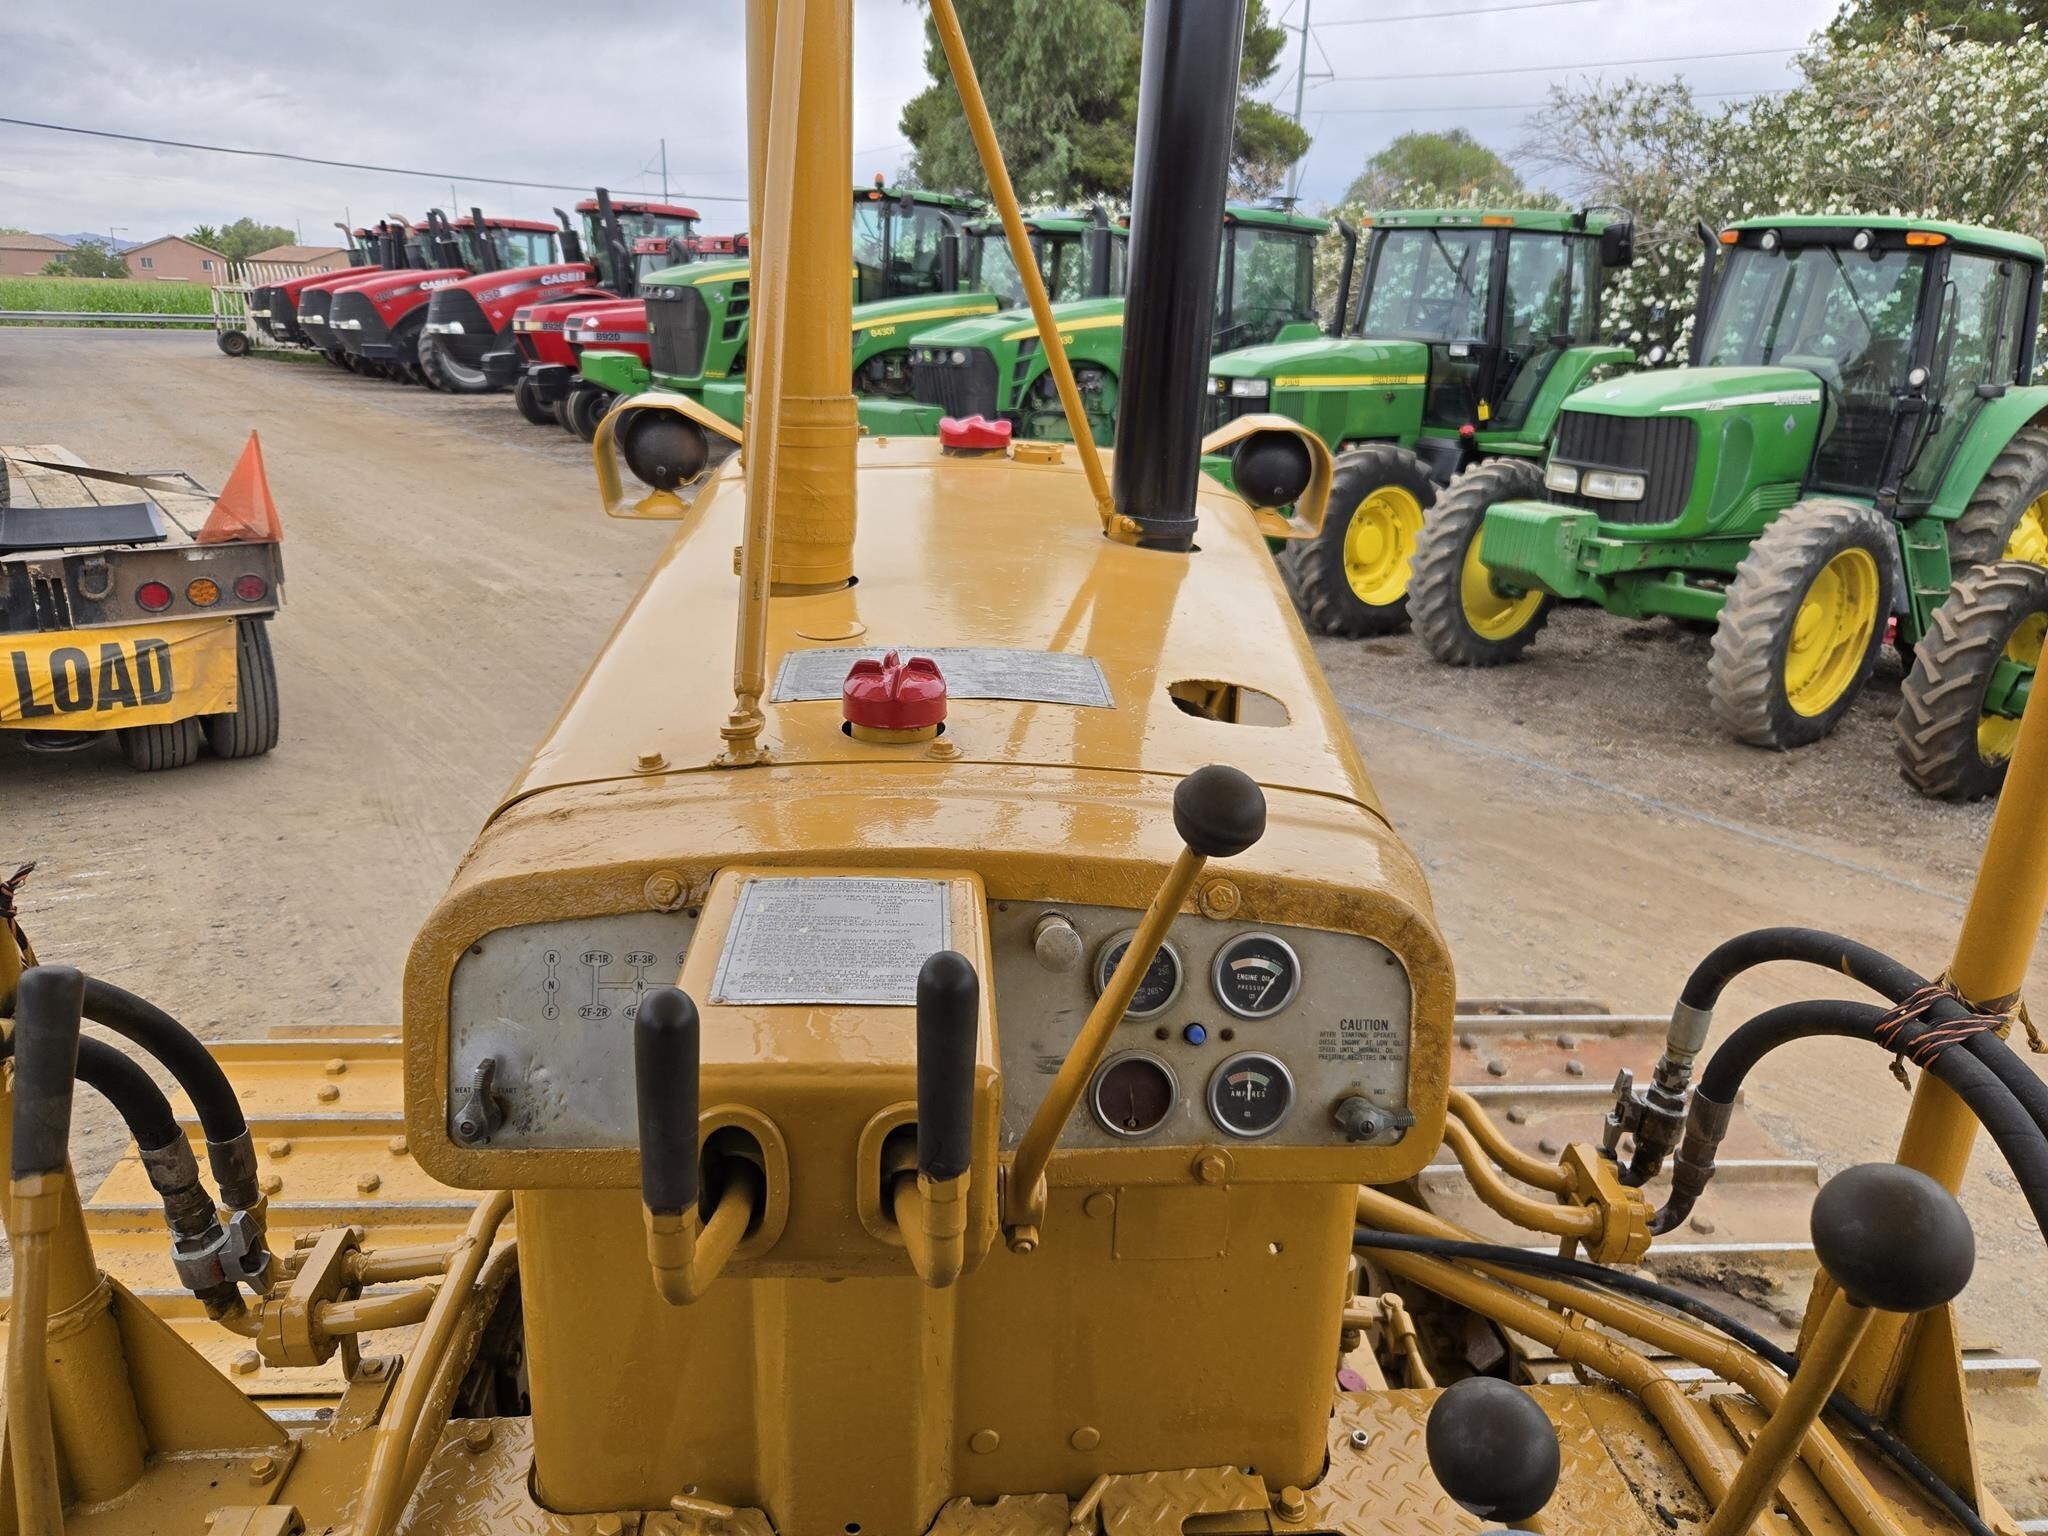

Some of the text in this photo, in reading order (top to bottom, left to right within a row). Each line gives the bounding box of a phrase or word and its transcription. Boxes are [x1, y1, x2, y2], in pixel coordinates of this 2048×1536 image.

[11, 638, 173, 719] LOAD
[549, 954, 555, 963] R
[585, 954, 609, 963] 1F-1R
[627, 955, 653, 964] 3F-3R
[1237, 973, 1258, 981] ENGINE
[549, 981, 555, 989] N
[637, 981, 643, 990] N
[548, 1008, 553, 1017] F
[581, 1008, 608, 1017] 2F-2R
[1340, 1019, 1389, 1031] CAUTION
[1231, 1090, 1266, 1098] AMPRES
